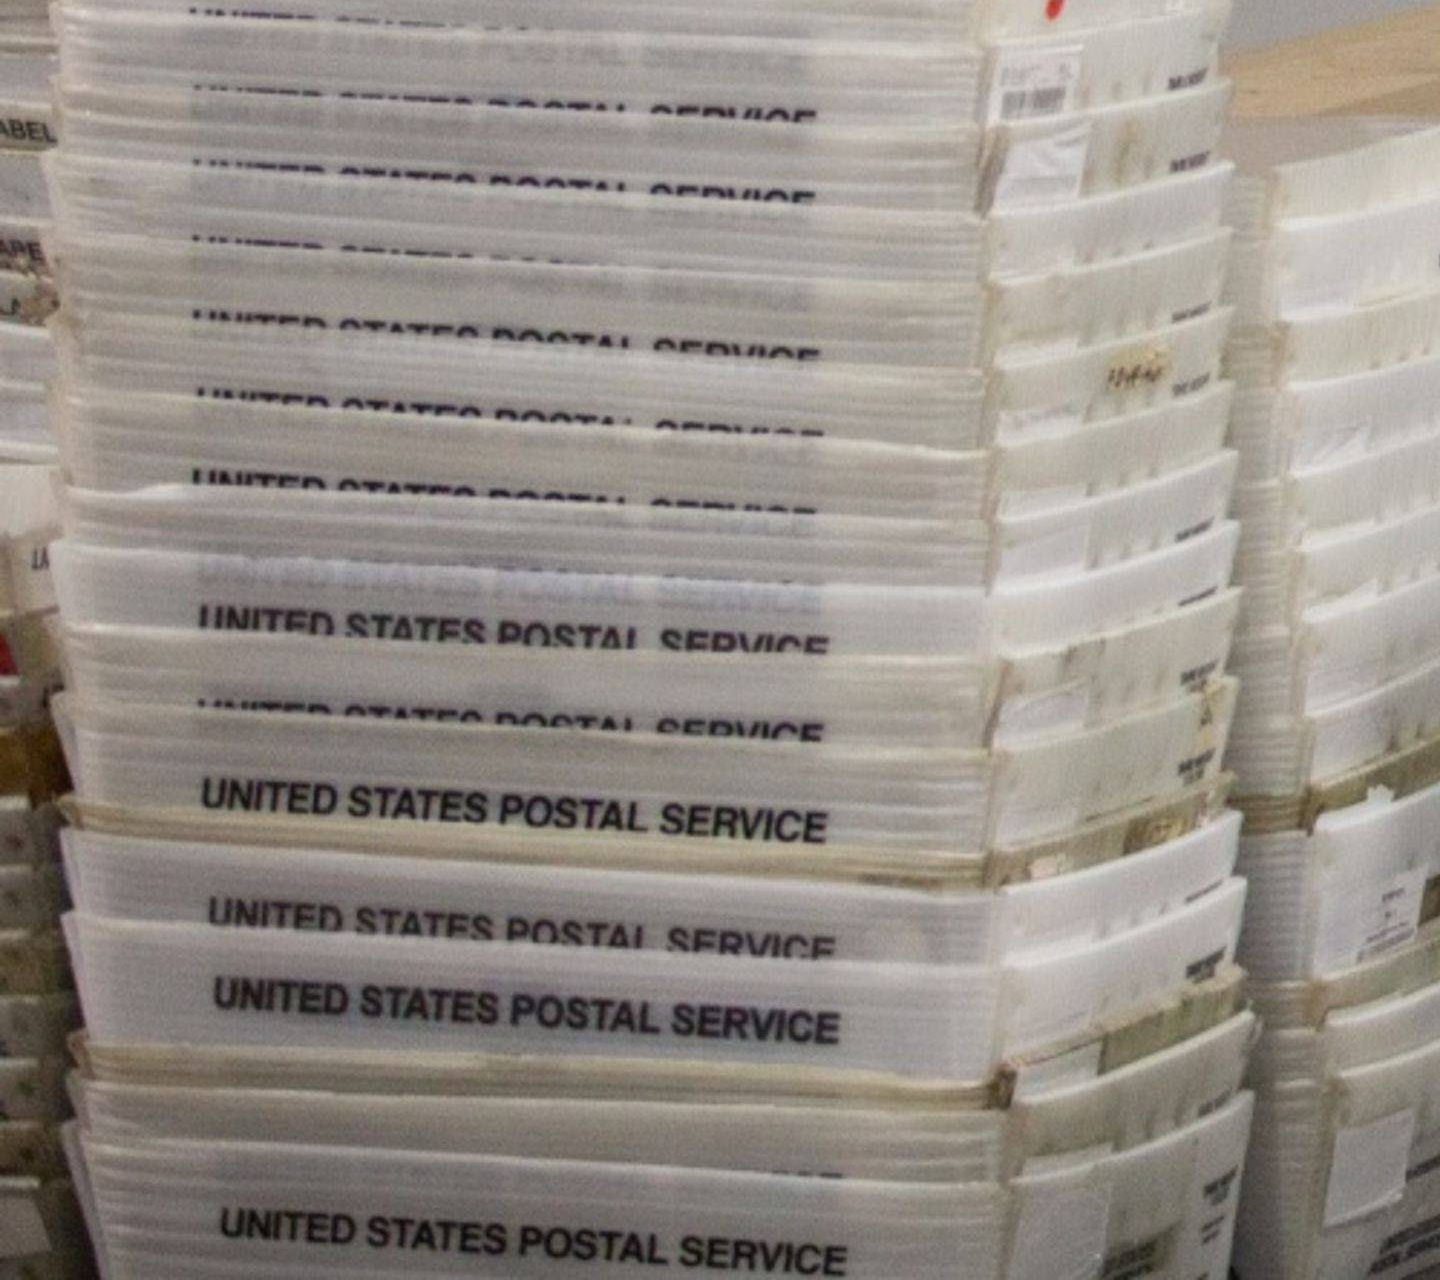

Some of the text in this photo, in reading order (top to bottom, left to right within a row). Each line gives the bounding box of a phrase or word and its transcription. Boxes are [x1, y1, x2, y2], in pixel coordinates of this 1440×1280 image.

[199, 604, 830, 655] UNITED STATES POSTAL SERVICE
[201, 776, 829, 845] UNITED STATES POSTAL SERVICE
[209, 896, 837, 960] UNITED STATES POSTAL SERVICE
[214, 976, 841, 1046] UNITED STATES POSTAL SERVICE
[220, 1206, 848, 1277] UNITED STATES POSTAL SERVICE
